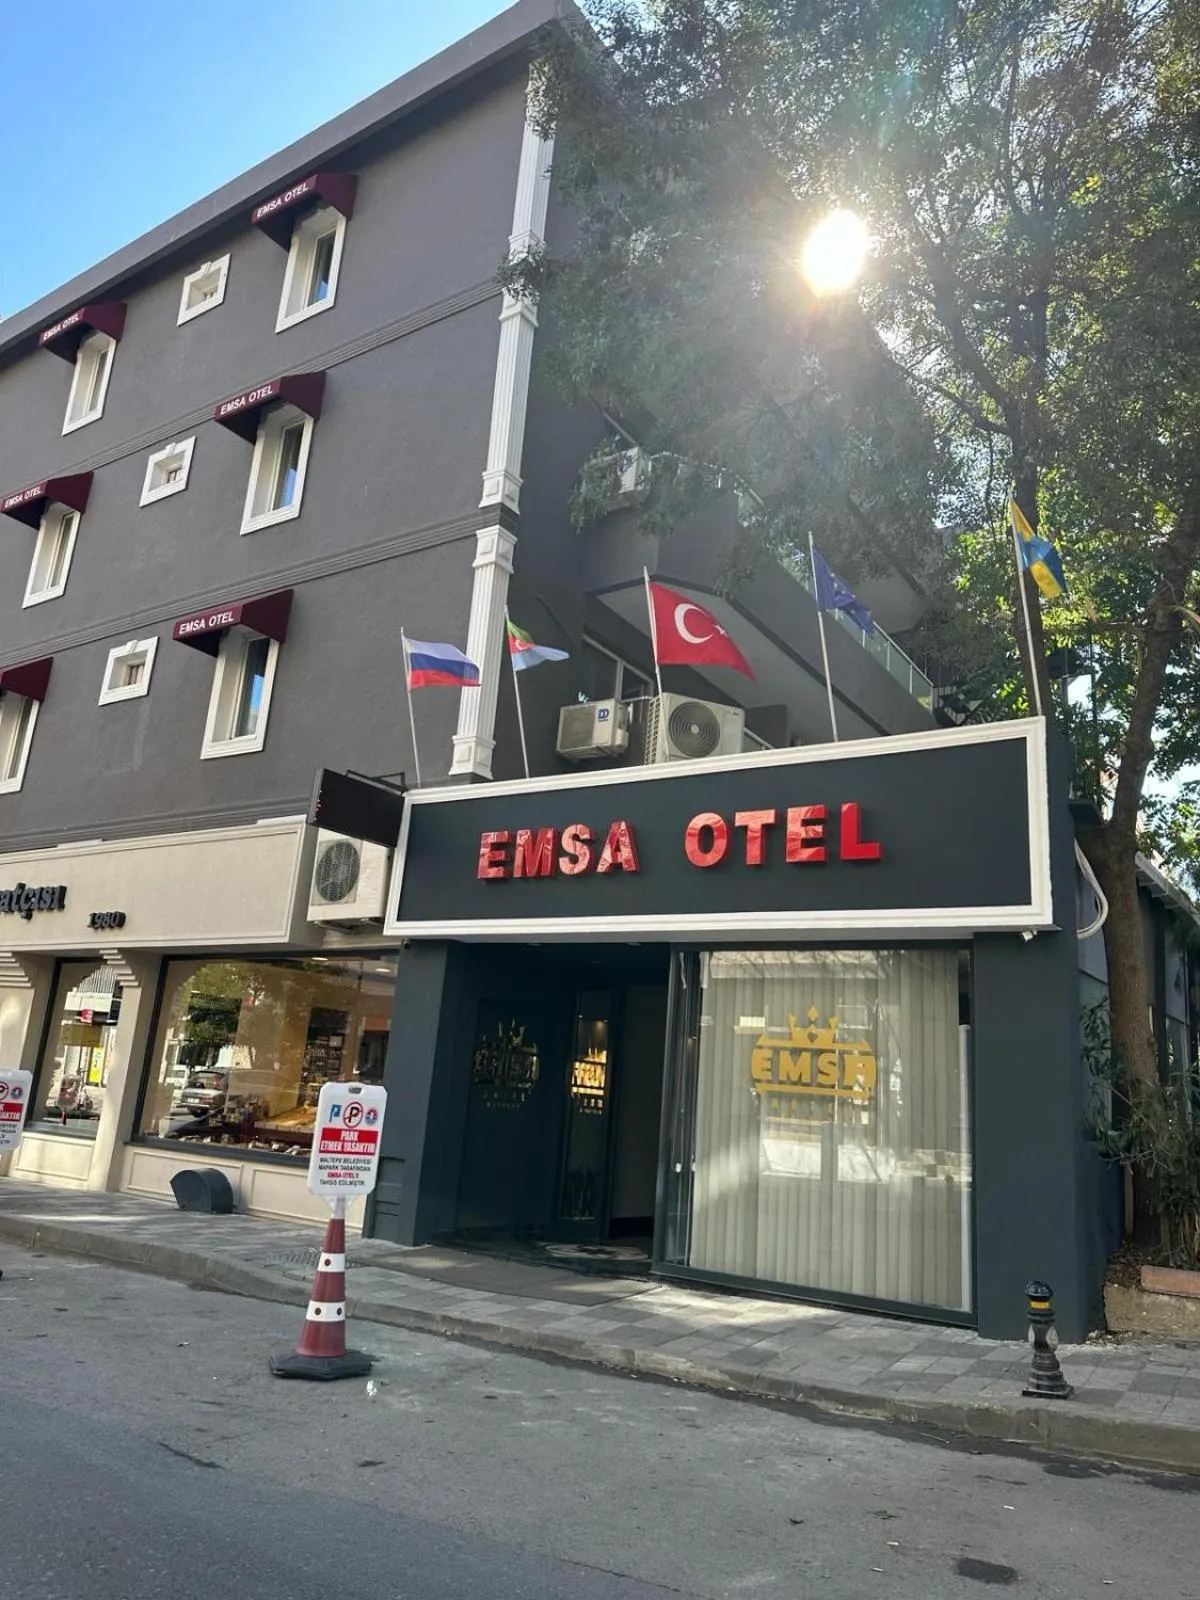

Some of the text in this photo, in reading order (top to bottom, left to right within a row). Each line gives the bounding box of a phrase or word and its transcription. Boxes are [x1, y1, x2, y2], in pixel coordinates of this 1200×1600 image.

[256, 182, 309, 219] EMSA OTEL
[220, 384, 273, 416] EMSA OTEL
[4, 486, 42, 509] EMSA OTEL
[179, 610, 235, 636] EMSA OTEL
[477, 802, 881, 881] EMSA OTEL
[87, 911, 127, 930] 1980
[751, 1048, 877, 1089] EMSA
[320, 1140, 376, 1153] ETMEK YASAKTIR
[340, 1130, 359, 1141] PARK
